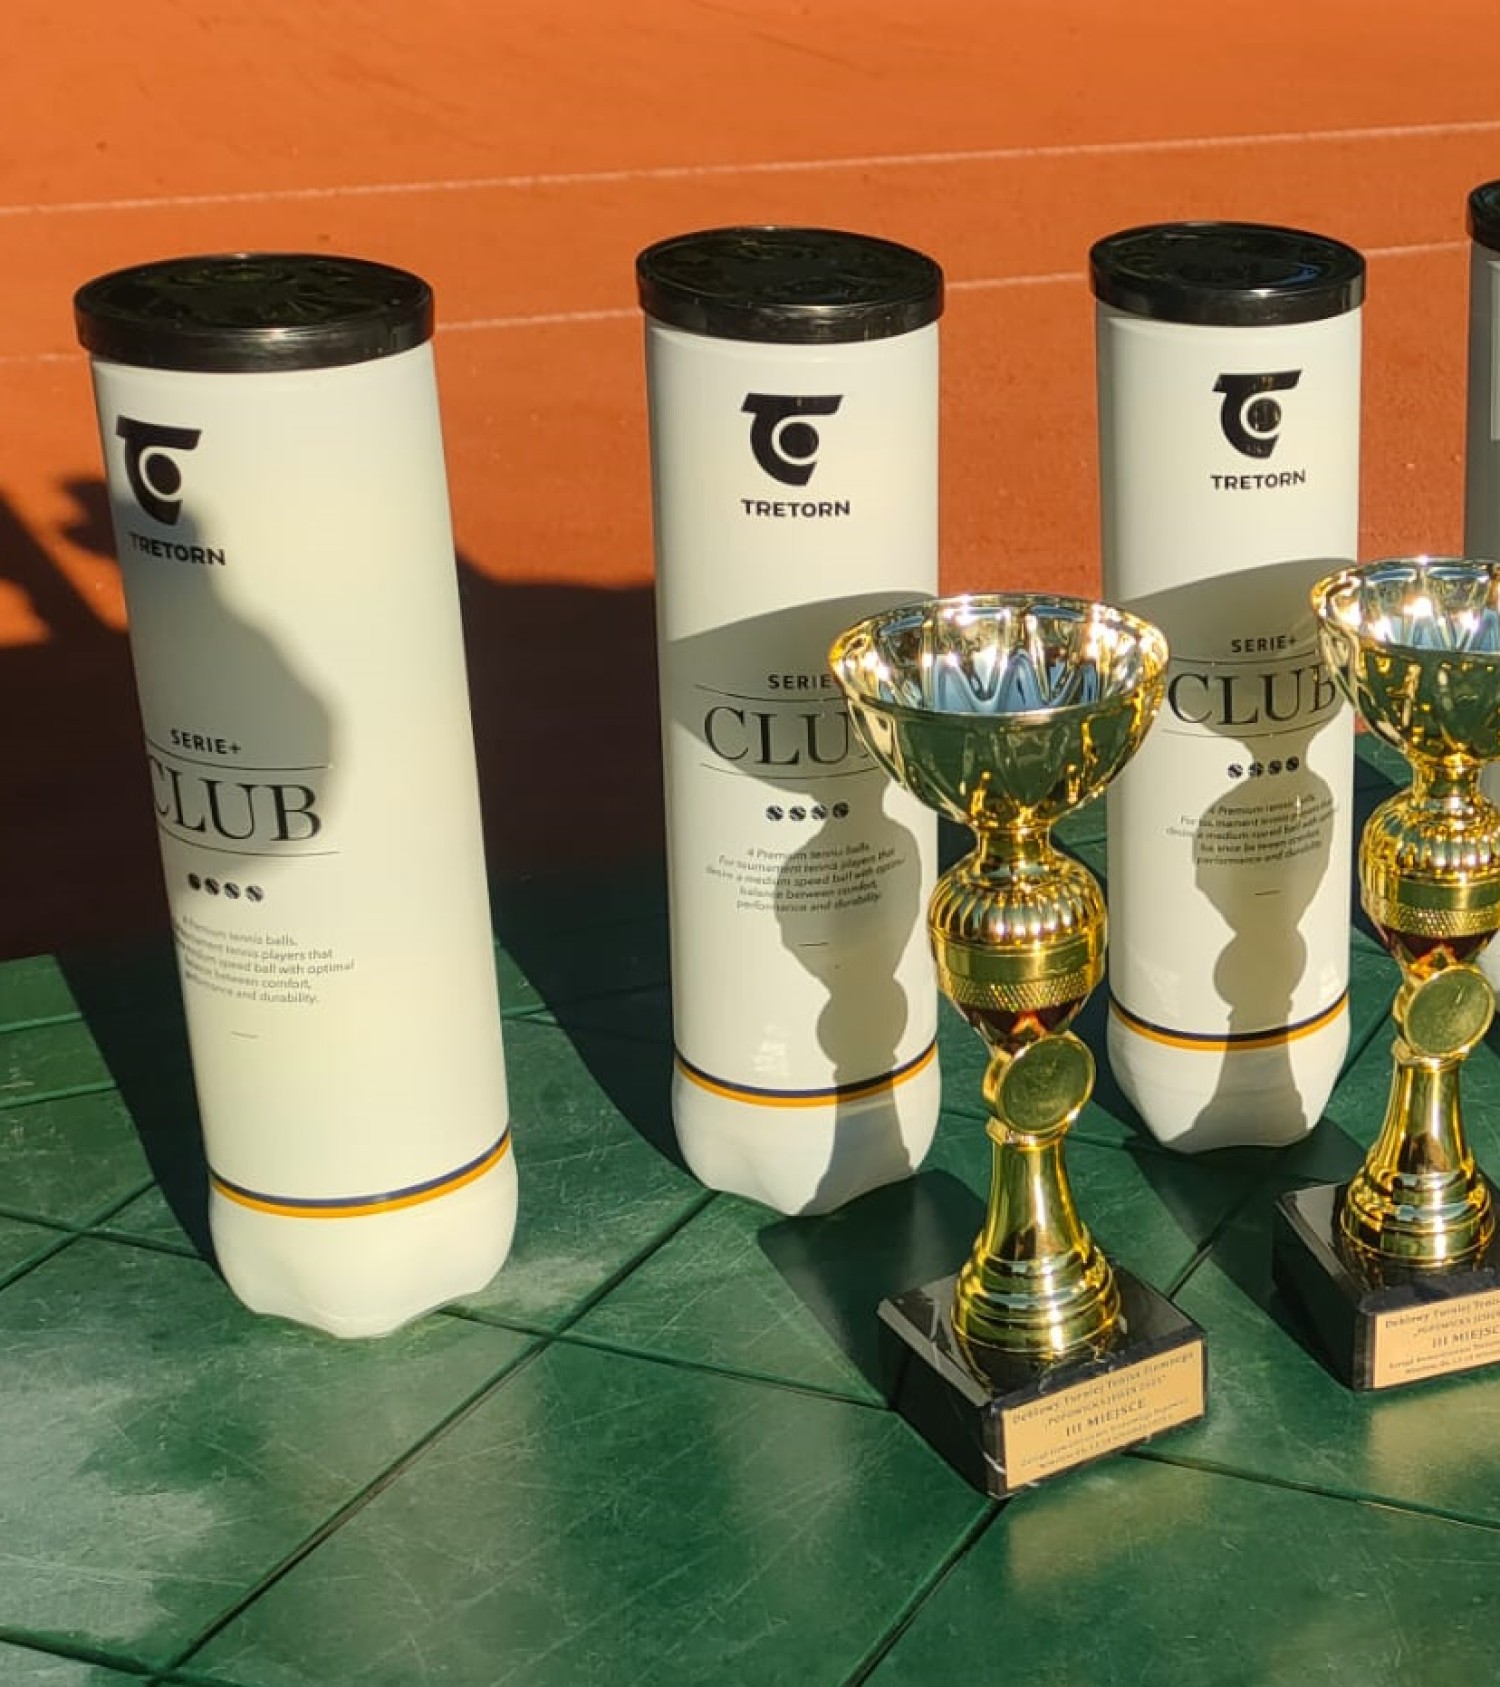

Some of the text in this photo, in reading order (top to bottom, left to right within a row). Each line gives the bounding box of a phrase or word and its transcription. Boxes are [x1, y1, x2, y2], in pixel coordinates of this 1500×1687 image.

[1210, 469, 1306, 490] TRETORN
[741, 498, 850, 518] TRETORN
[128, 531, 226, 566] TRETORN
[1231, 635, 1296, 653] SERIE+
[767, 673, 832, 690] SERIE
[171, 728, 241, 755] SERIE+
[704, 706, 868, 766] CLU
[262, 949, 306, 963] players
[308, 949, 332, 960] that
[254, 961, 276, 974] ball
[278, 963, 305, 974] with
[308, 958, 356, 976] optimal
[1432, 1336, 1448, 1348] III
[1066, 1422, 1082, 1436] III
[1087, 1399, 1144, 1429] MIEJSCE
